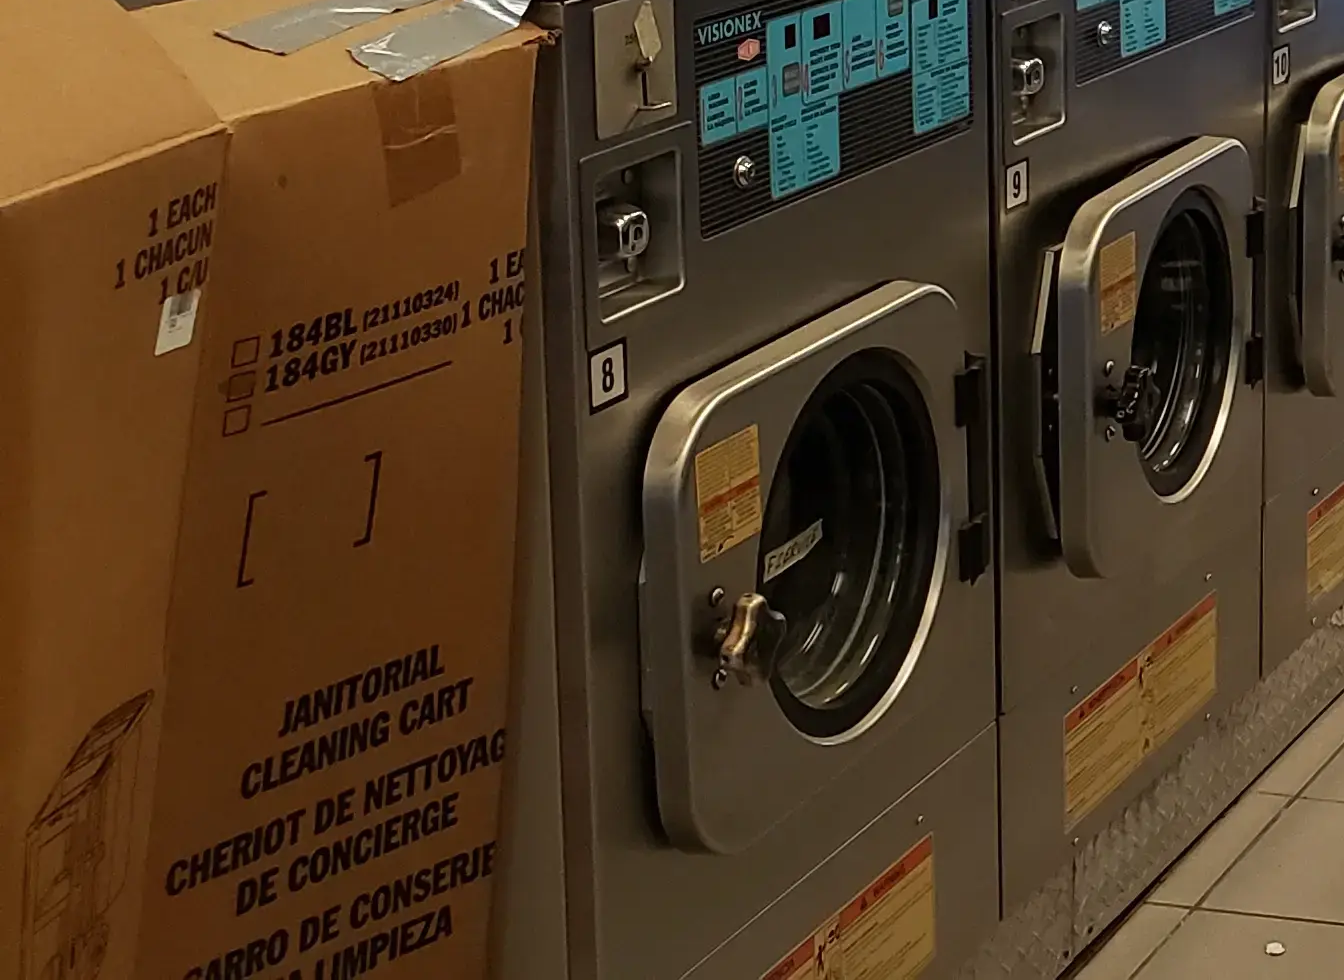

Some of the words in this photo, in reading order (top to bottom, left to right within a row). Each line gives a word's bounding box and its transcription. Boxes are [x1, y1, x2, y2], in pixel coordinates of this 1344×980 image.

[698, 10, 762, 47] VISIONEX
[1275, 52, 1287, 77] 10
[1012, 170, 1021, 198] 9
[148, 207, 158, 237] 1
[166, 182, 217, 229] EACH
[115, 259, 126, 289] 1
[134, 220, 213, 280] CHACUN
[489, 258, 499, 285] 1
[159, 276, 168, 305] 1
[176, 257, 209, 295] C/U
[269, 307, 358, 358] 184BL
[362, 280, 459, 332] (21110324)
[461, 301, 471, 329] 1
[503, 318, 512, 345] 1
[264, 339, 358, 393] 184GY
[360, 313, 458, 366] (21110330)
[602, 357, 614, 393] 8
[278, 644, 445, 739] JANITORIAL
[240, 710, 390, 801] CLEANING
[398, 676, 474, 736] CART
[164, 808, 306, 898] CHERIOT
[314, 788, 356, 837] DE
[236, 866, 280, 918] DE
[288, 792, 459, 893] CONCIERGE
[299, 904, 342, 953] DE
